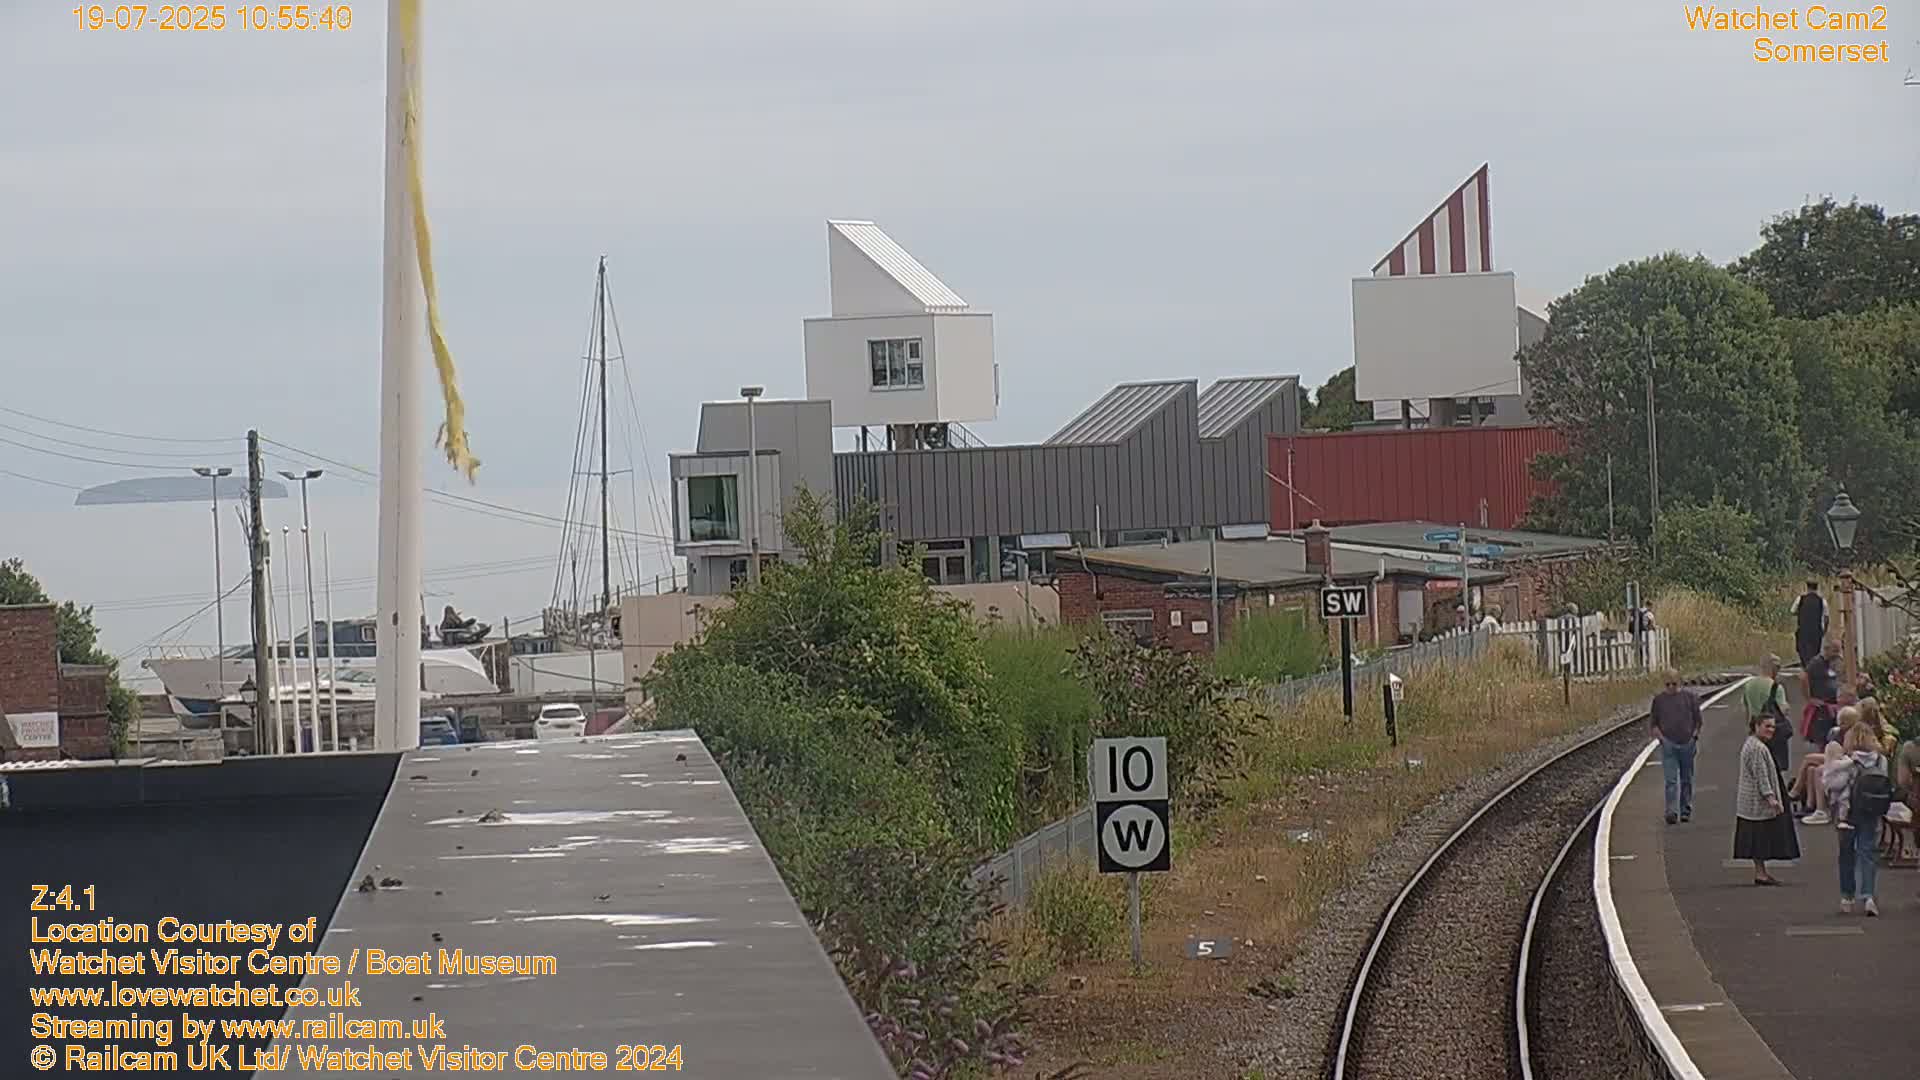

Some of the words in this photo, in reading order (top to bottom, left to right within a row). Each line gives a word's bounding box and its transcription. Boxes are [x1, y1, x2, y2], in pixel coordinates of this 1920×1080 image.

[1327, 592, 1361, 613] SW
[1108, 745, 1154, 793] 10
[1111, 819, 1154, 852] W
[1197, 941, 1215, 956] 5
